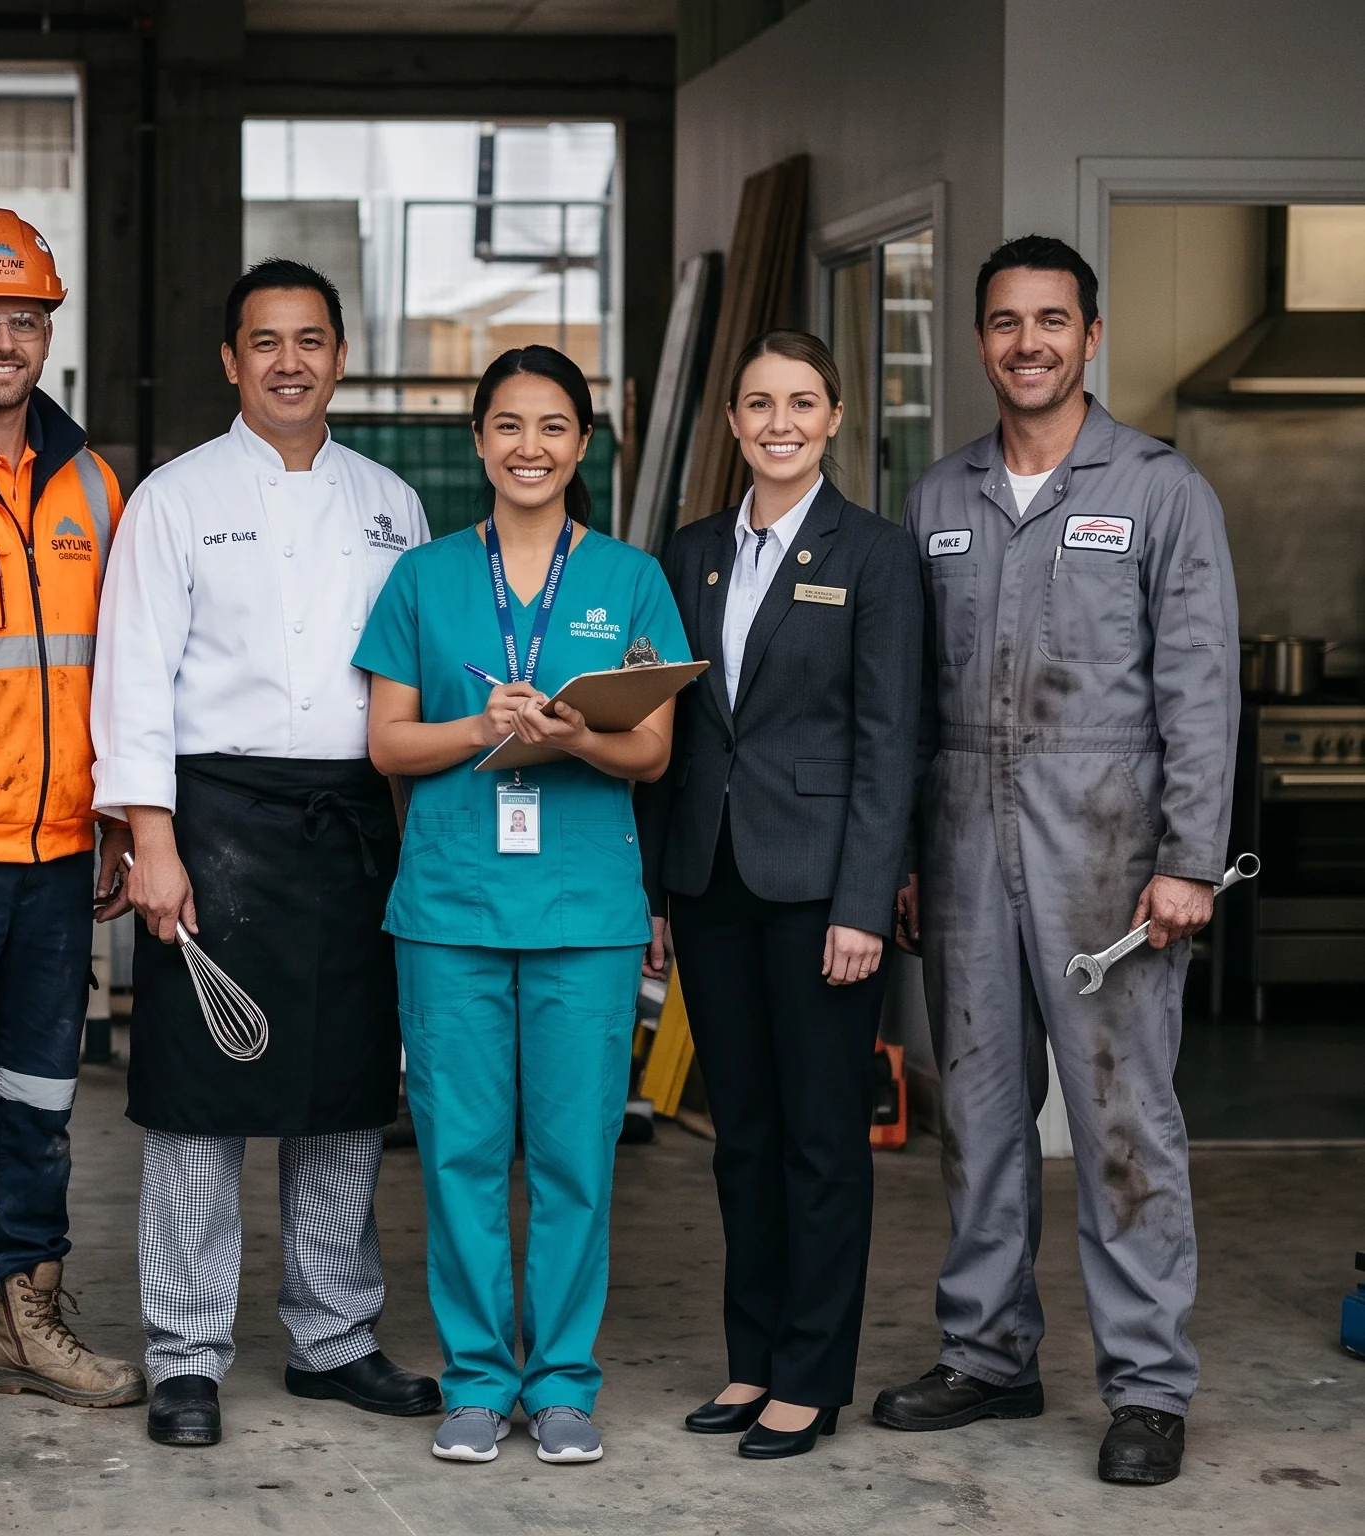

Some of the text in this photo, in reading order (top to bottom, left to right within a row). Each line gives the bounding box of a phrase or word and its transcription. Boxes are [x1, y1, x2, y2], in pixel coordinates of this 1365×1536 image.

[203, 533, 228, 546] CHEF
[364, 529, 381, 541] THE
[1069, 532, 1097, 542] AUTO
[51, 539, 92, 552] SKYLINE
[937, 538, 960, 549] MIKE
